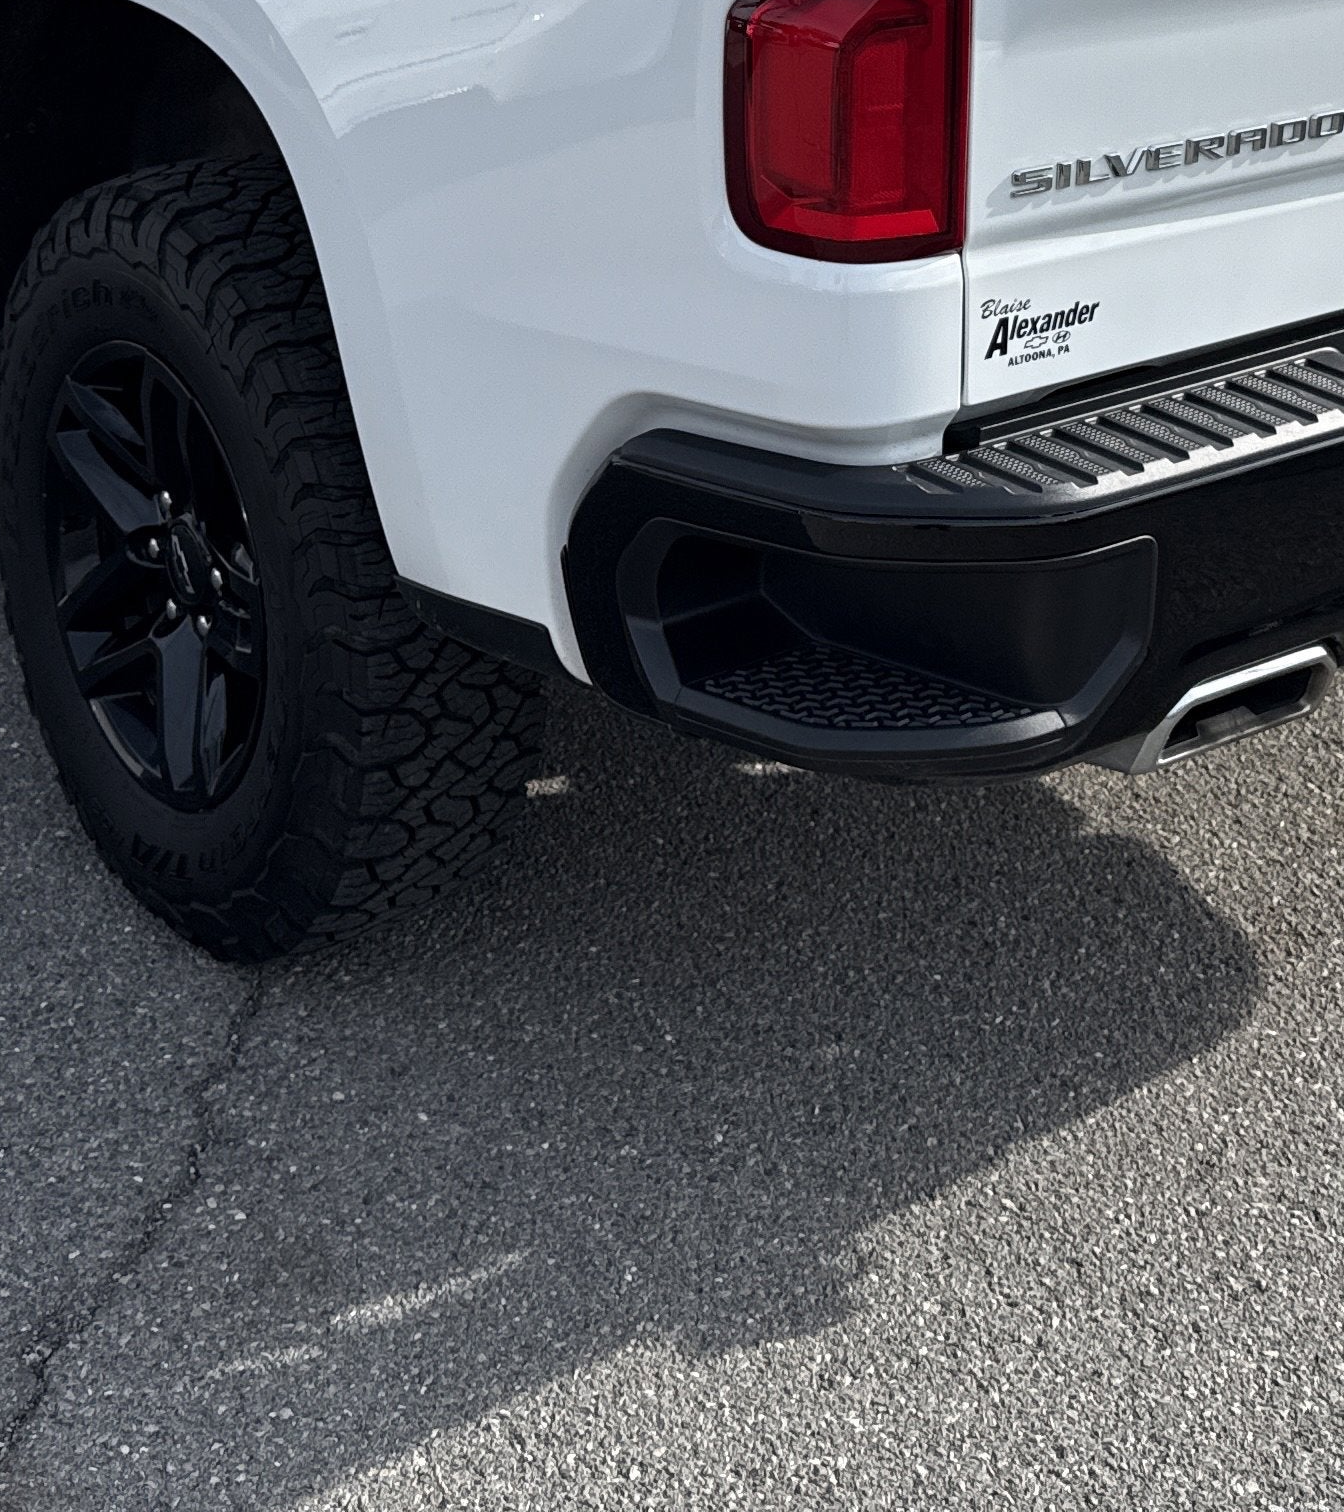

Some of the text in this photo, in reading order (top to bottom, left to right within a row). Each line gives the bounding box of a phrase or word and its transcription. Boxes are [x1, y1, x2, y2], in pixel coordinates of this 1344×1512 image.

[980, 298, 1032, 320] Blaise
[984, 301, 1100, 360] Alexander
[1007, 343, 1071, 368] ALTOONA, PA
